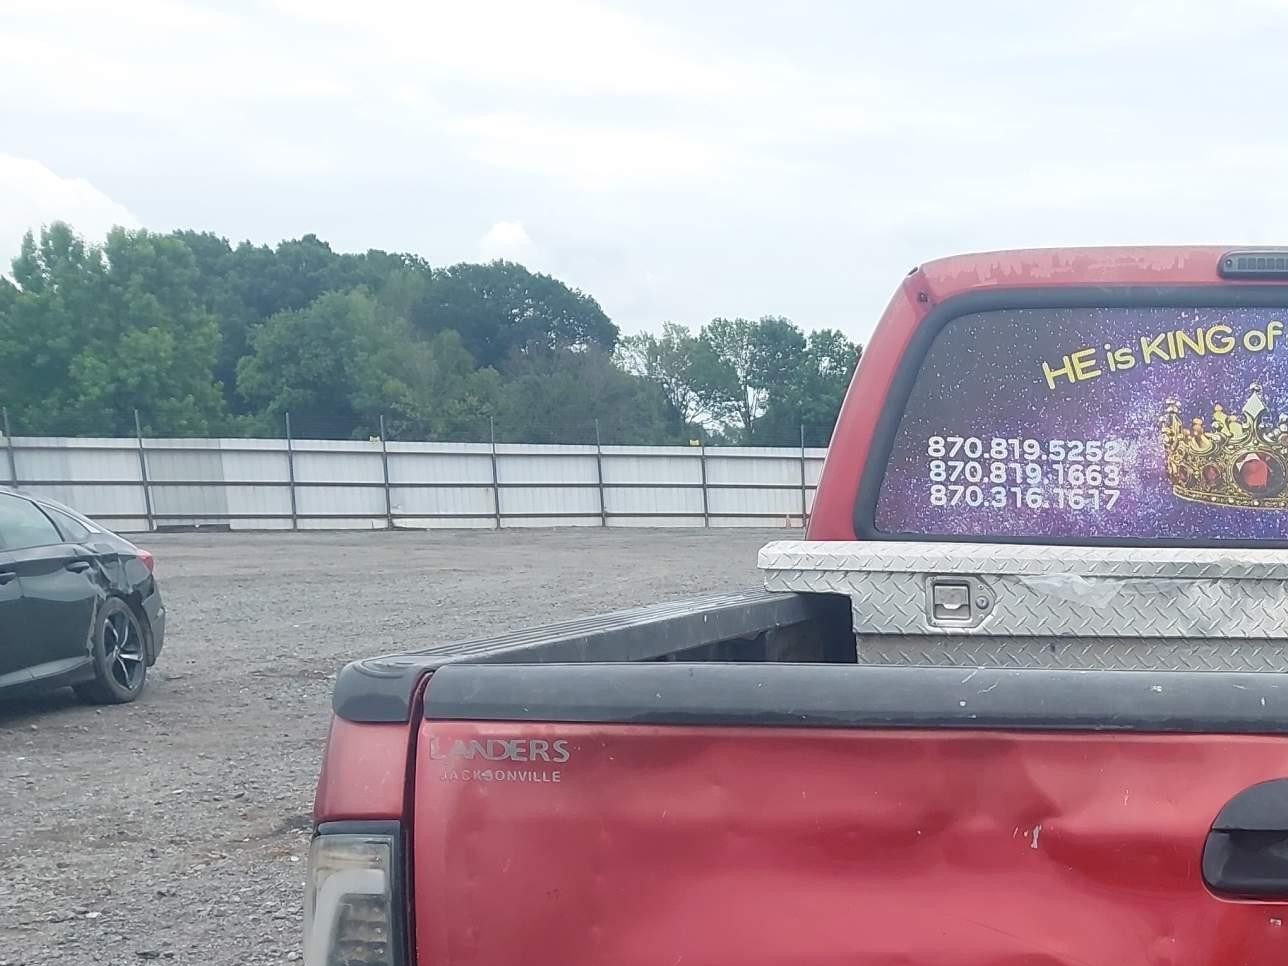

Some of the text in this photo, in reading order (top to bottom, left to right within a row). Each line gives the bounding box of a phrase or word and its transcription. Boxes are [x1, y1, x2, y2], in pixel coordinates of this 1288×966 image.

[1042, 348, 1101, 389] HE
[1104, 343, 1135, 371] is
[1140, 325, 1236, 363] KING
[1243, 321, 1284, 351] of
[928, 436, 1122, 462] 870.819.5252
[929, 460, 1121, 487] 870.819.1663
[930, 484, 1121, 510] 870.316.1617
[430, 738, 571, 763] LANDERS
[440, 769, 561, 783] JACKSONVILLE
